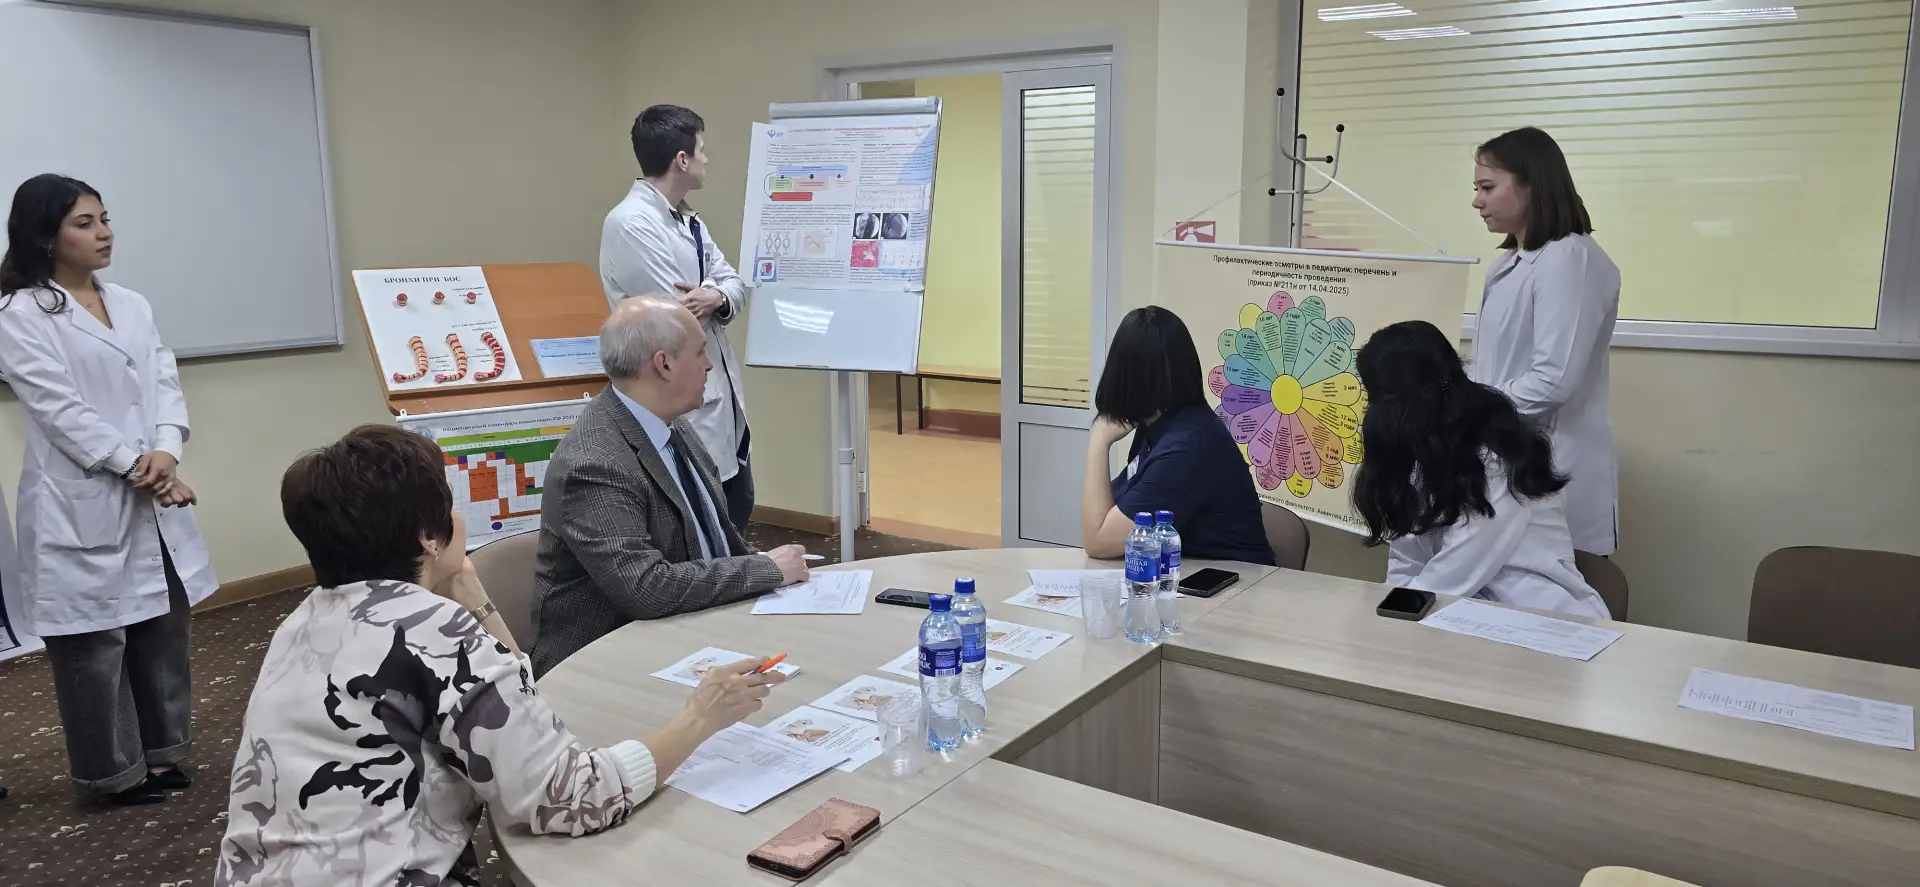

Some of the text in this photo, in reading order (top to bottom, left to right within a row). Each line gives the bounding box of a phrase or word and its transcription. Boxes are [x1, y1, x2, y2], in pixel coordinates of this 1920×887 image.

[1213, 255, 1273, 267] Профилактические
[1274, 261, 1305, 271] осмотры
[1312, 263, 1353, 274] педиатрии:
[1354, 267, 1390, 277] перечень
[1252, 269, 1346, 284] периодичность проведения
[1247, 278, 1273, 288] (приказ
[1273, 280, 1297, 290] №211н
[1309, 284, 1350, 296] 14.04.2025)
